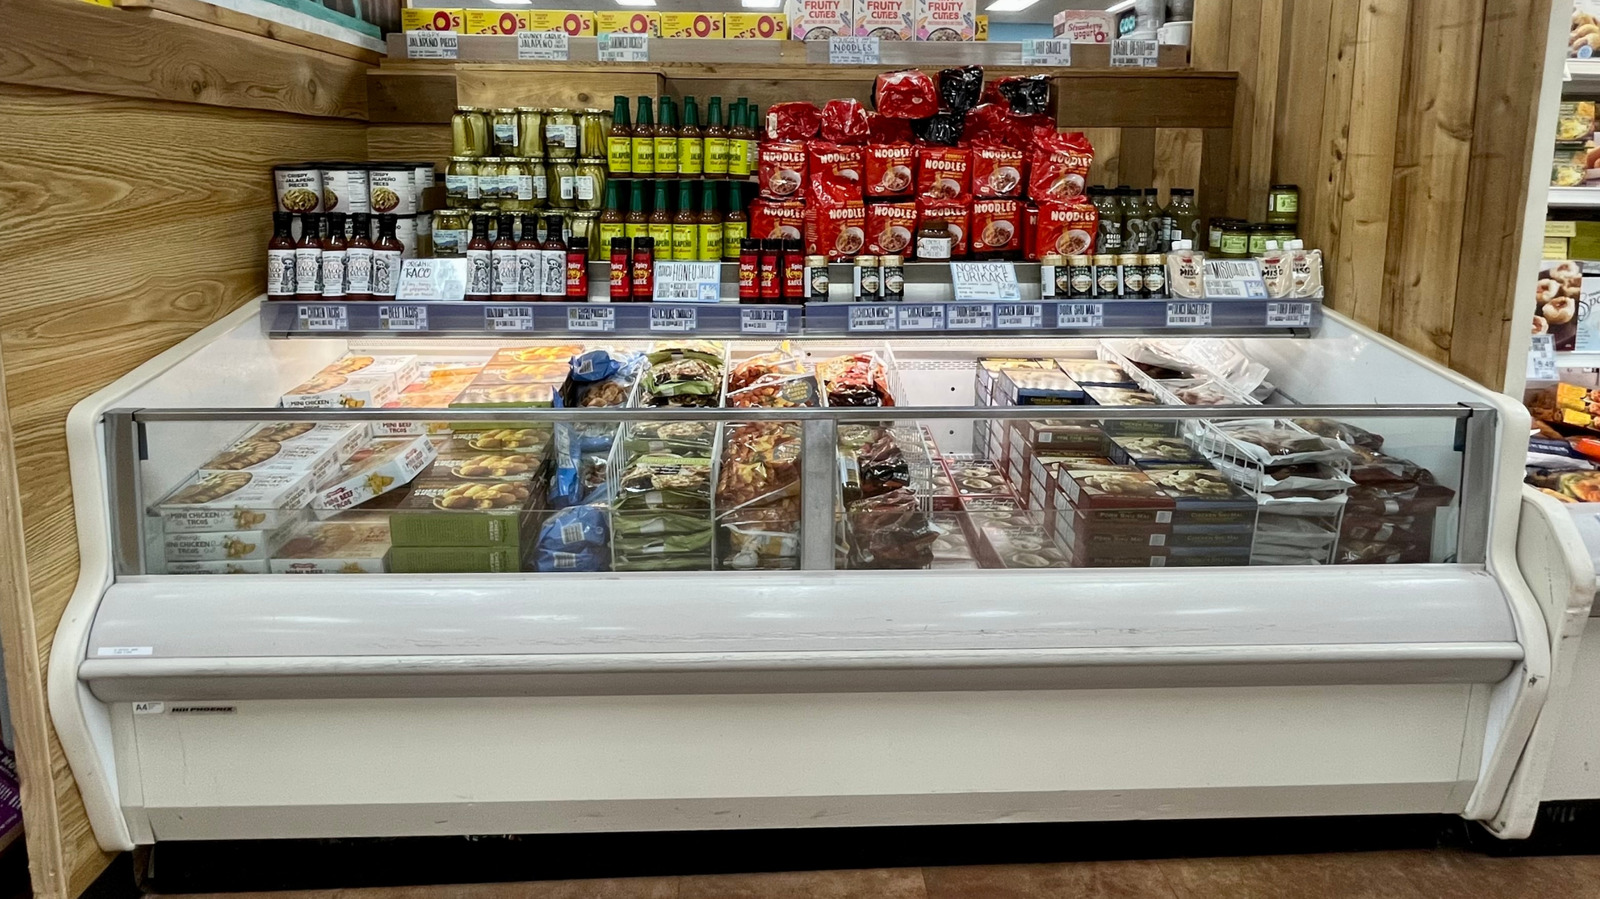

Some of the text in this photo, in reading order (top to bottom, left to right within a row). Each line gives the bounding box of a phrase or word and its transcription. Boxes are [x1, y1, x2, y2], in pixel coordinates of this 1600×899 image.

[802, 1, 840, 9] FRUITY
[867, 2, 902, 10] FRUITY
[928, 2, 963, 11] FRUITY
[932, 12, 959, 20] CUTIES
[1068, 21, 1103, 32] Strawberry
[1073, 30, 1097, 39] yogurt
[763, 152, 805, 162] NOODLES
[820, 153, 861, 164] NOODLES
[981, 149, 1022, 159] NOODLES
[925, 159, 966, 171] NOODLES
[1050, 154, 1093, 166] NOODLES
[764, 207, 805, 218] NOODLES
[875, 206, 918, 219] NOODLES
[925, 207, 967, 216] NOODLES
[974, 202, 1017, 214] NOODLES
[829, 208, 865, 219] NOODLES
[1051, 211, 1096, 221] NOODLES
[673, 264, 697, 281] HONEY
[956, 264, 980, 273] NORI
[956, 272, 1009, 283] FURIKAKE
